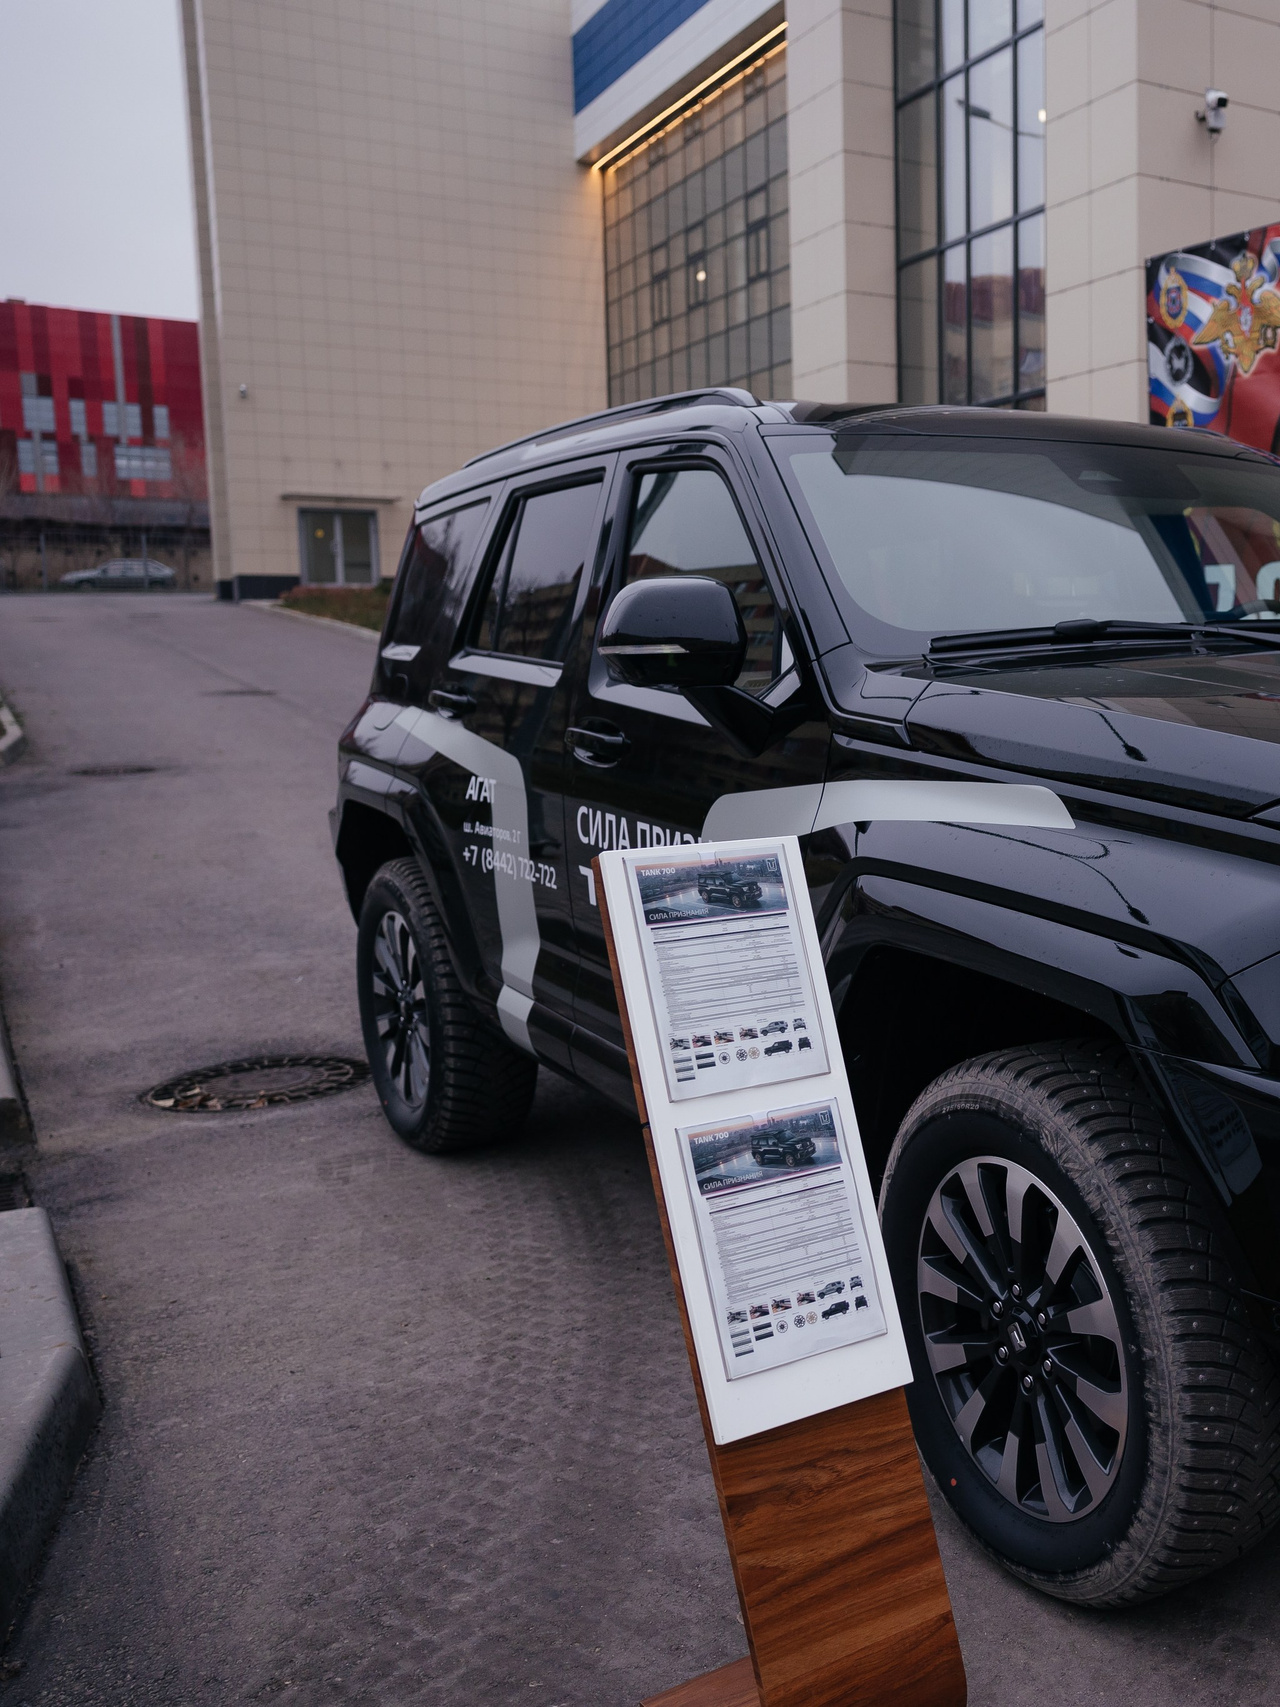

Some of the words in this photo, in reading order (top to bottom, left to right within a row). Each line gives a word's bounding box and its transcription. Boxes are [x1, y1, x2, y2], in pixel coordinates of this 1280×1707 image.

[465, 776, 496, 804] АГАТ
[577, 805, 631, 850] СИЛА
[462, 845, 478, 866] +7
[481, 848, 517, 880] (8442)
[518, 856, 557, 890] 722-722
[641, 868, 661, 877] TANK
[662, 867, 676, 875] 700
[649, 912, 669, 921] СИЛА
[668, 907, 709, 919] ПРИЗНАНИЯ
[694, 1134, 714, 1145] TANK
[715, 1131, 729, 1141] 700
[703, 1179, 722, 1192] СИЛА
[722, 1170, 764, 1187] ПРИЗНАНИЯ
